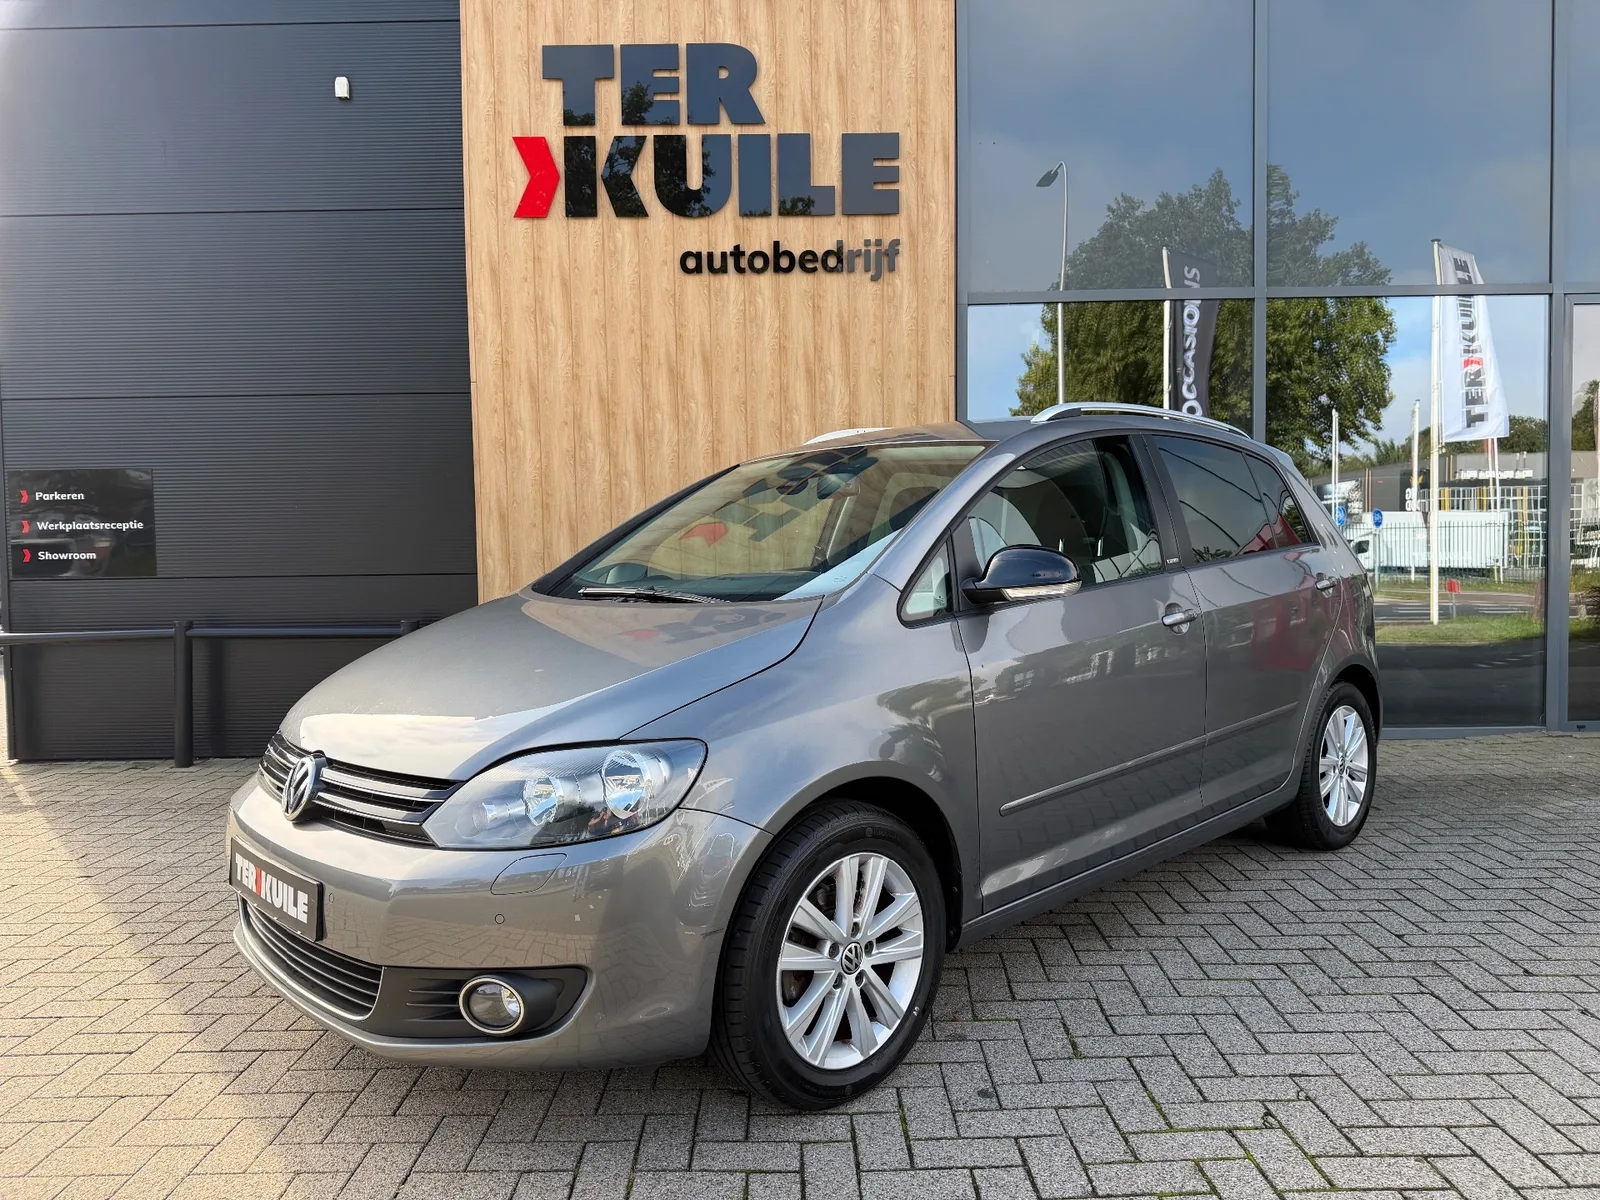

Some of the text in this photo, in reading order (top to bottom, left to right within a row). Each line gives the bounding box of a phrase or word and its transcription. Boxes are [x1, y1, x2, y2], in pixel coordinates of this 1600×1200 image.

[542, 42, 766, 126] TER
[563, 132, 900, 218] KUILE
[679, 239, 900, 281] autobedrijf
[1463, 368, 1489, 428] TER
[35, 491, 85, 501] Parkeren
[36, 520, 144, 532] Werkplaatsreceptie
[38, 551, 96, 560] Showroom
[235, 852, 308, 924] TER KUILE
